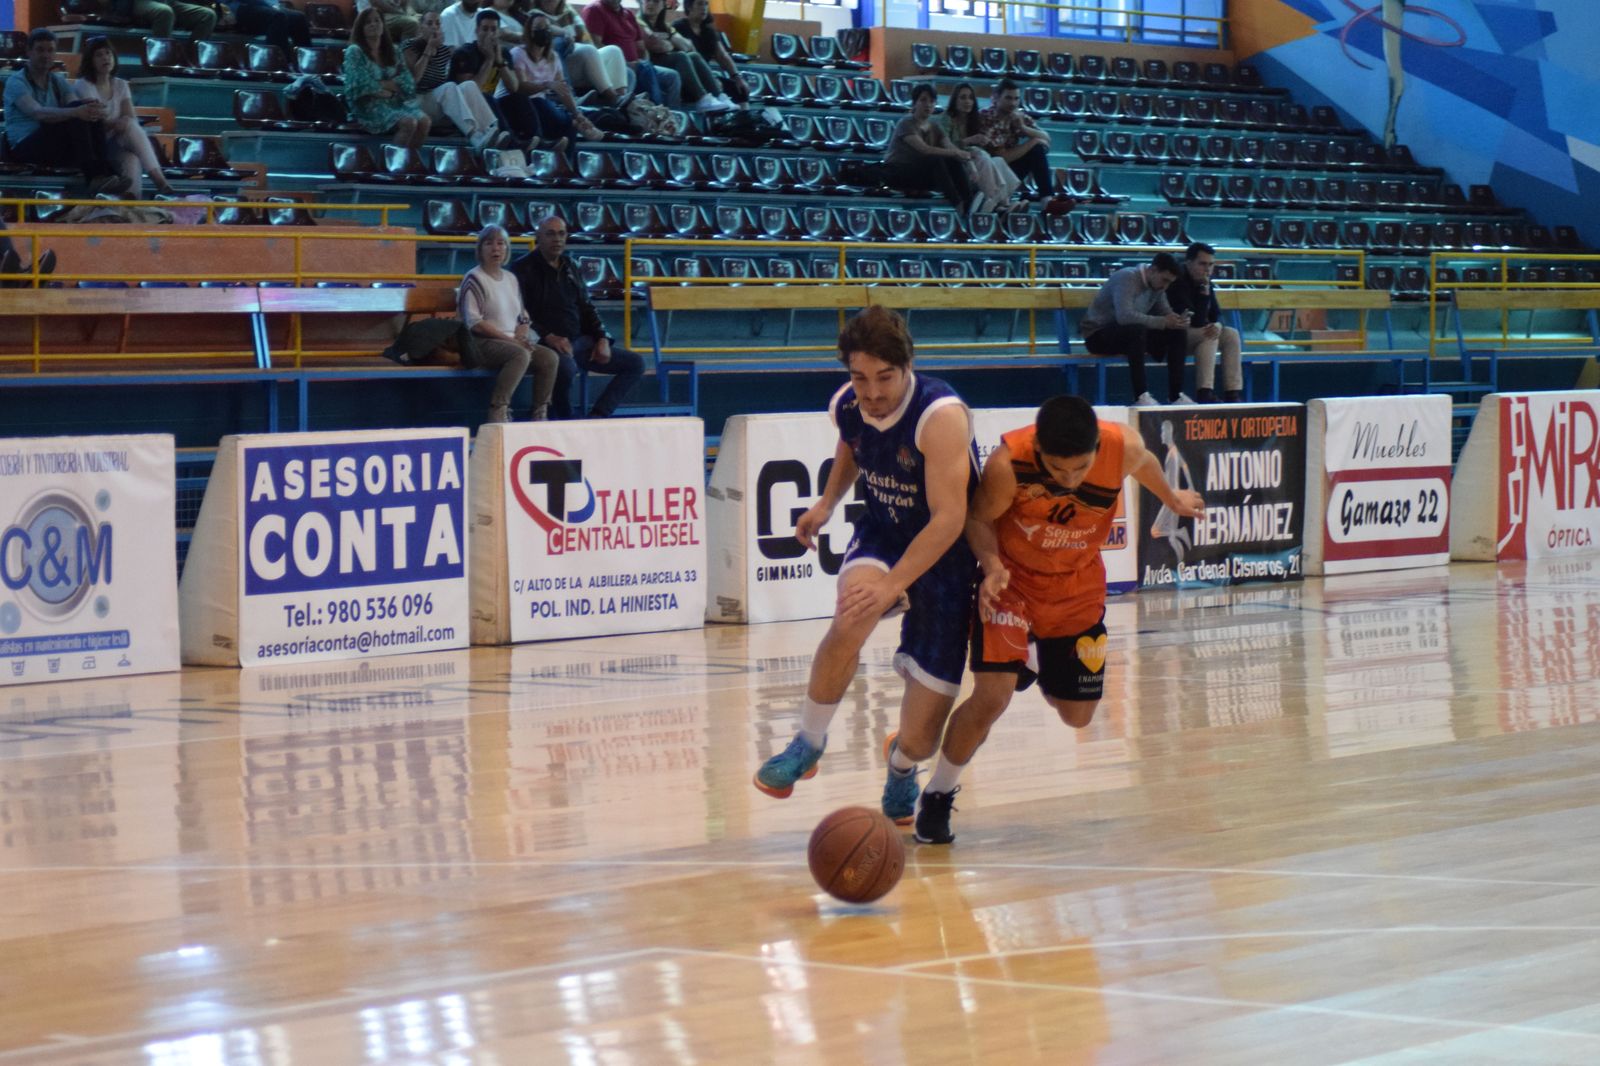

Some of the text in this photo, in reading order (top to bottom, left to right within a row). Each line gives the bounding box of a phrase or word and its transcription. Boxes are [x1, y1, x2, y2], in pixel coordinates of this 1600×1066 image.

[1184, 414, 1298, 441] TÉCNICA Y ORTOPEDIA
[1352, 419, 1427, 462] Muebles
[250, 450, 460, 502] ASESORIA
[1206, 449, 1282, 491] ANTONIO
[596, 486, 698, 524] TALLER
[1193, 495, 1293, 546] HERNÁNDEZ
[1341, 488, 1438, 536] Gamazo 22
[1, 520, 112, 589] C&M
[249, 504, 461, 581] CONTA
[549, 522, 700, 552] CENTRAL DIESEL
[1547, 525, 1592, 548] ÓPTICA
[513, 570, 697, 594] C/ ALTO DE LA ALBILLERA PARCELA 33
[757, 563, 813, 582] GIMNASIO
[1143, 563, 1176, 586] Avda.
[1177, 559, 1229, 582] Cardenal
[1232, 555, 1287, 578] Cisneros,
[284, 592, 433, 628] Tel.: 980 536 096
[530, 593, 679, 618] POL. IND. LA HINIESTA
[257, 625, 455, 659] asesoriaconta@hotmail.com
